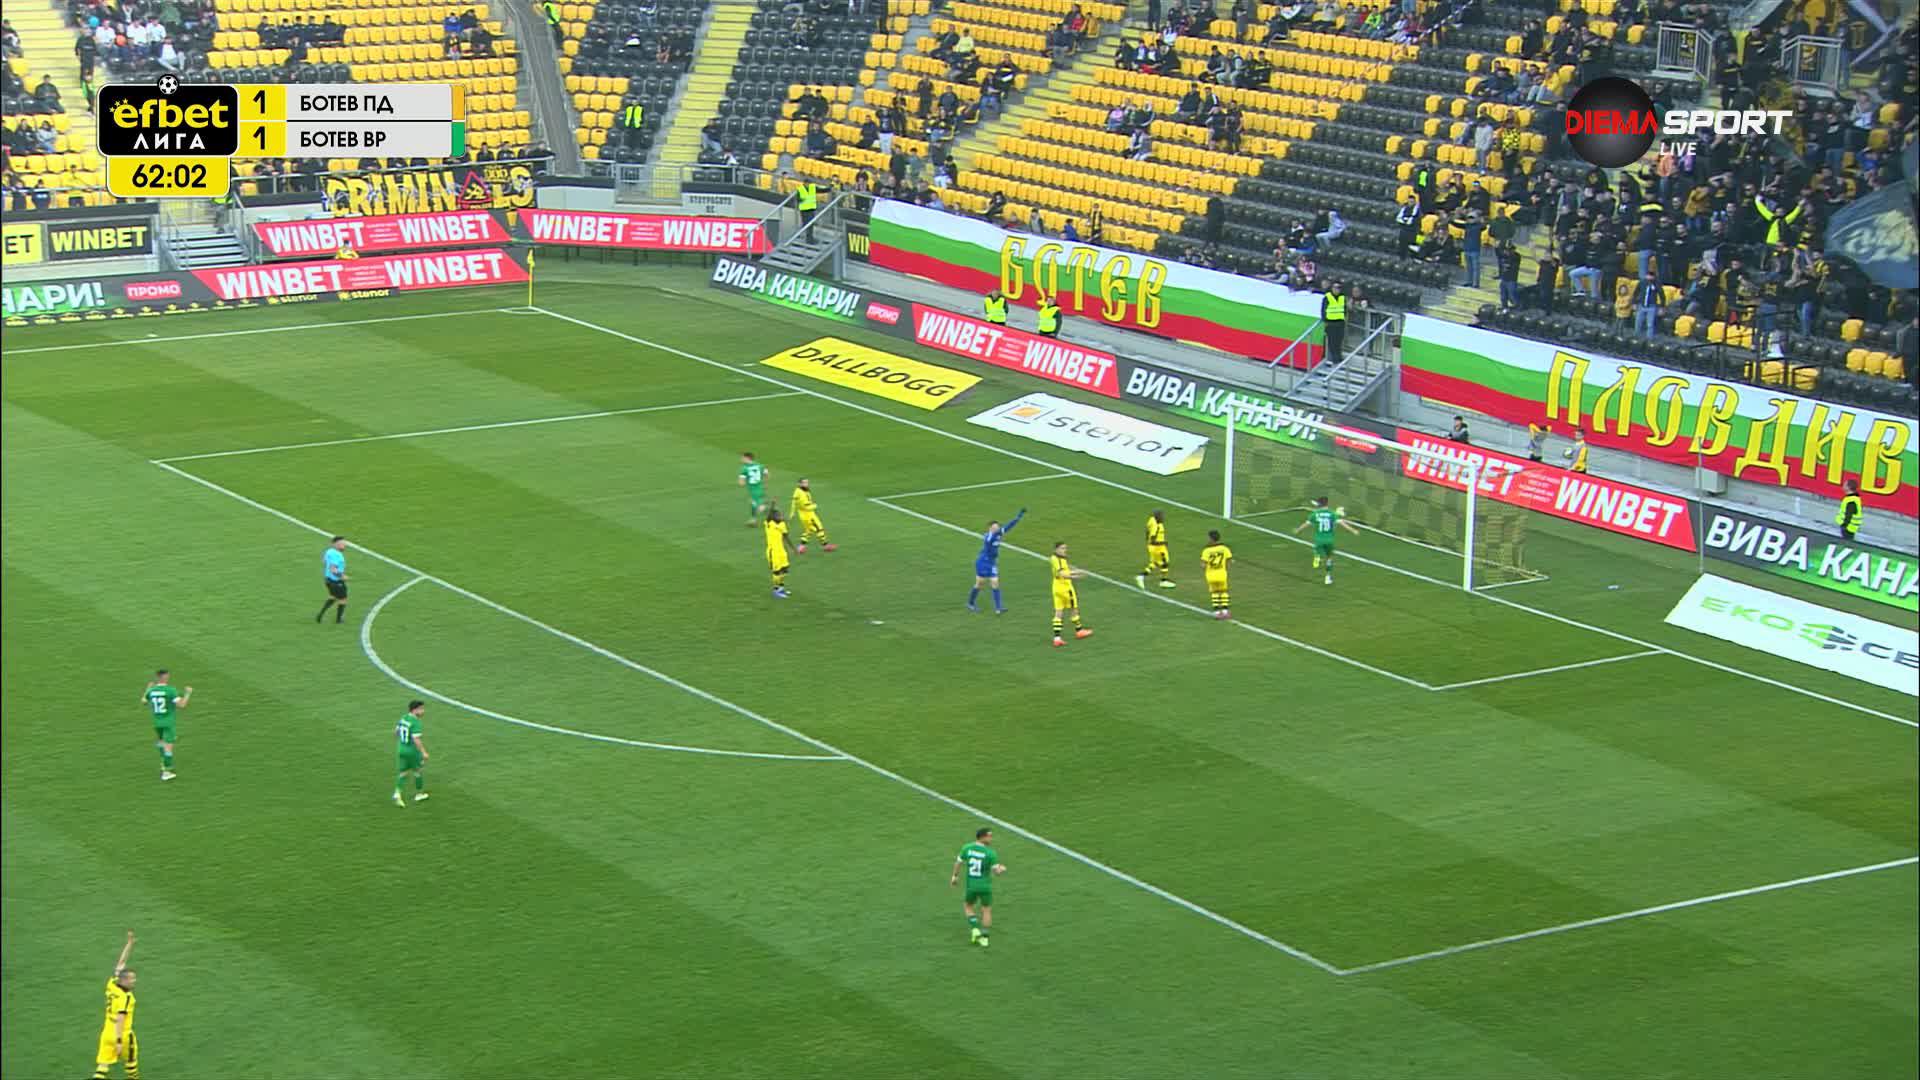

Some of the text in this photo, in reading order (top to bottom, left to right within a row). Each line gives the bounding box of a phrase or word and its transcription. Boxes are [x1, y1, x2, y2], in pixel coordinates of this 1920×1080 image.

[51, 225, 148, 253] WINBET
[266, 221, 364, 252] WINBET
[398, 213, 491, 244] WINBET
[532, 213, 629, 243] WINBET
[662, 219, 760, 249] WINBET
[127, 283, 181, 298] ПРОМО
[216, 264, 344, 300] WINBET
[384, 252, 503, 288] WINBET
[713, 258, 861, 318] ВИВА КАНАРИ!
[1001, 235, 1168, 329] БОТЕВ
[790, 347, 957, 397] DALLBOGG
[917, 311, 1004, 358] WINBET
[1023, 339, 1113, 387] WINBET
[1126, 367, 1197, 409] ВИВА
[1047, 414, 1184, 458] stenor
[1546, 350, 1912, 495] ПЛОВДИВ
[1553, 475, 1684, 538] WINBET
[1704, 514, 1809, 571] ВИВА
[151, 697, 168, 713] 12
[968, 857, 983, 877] 21
